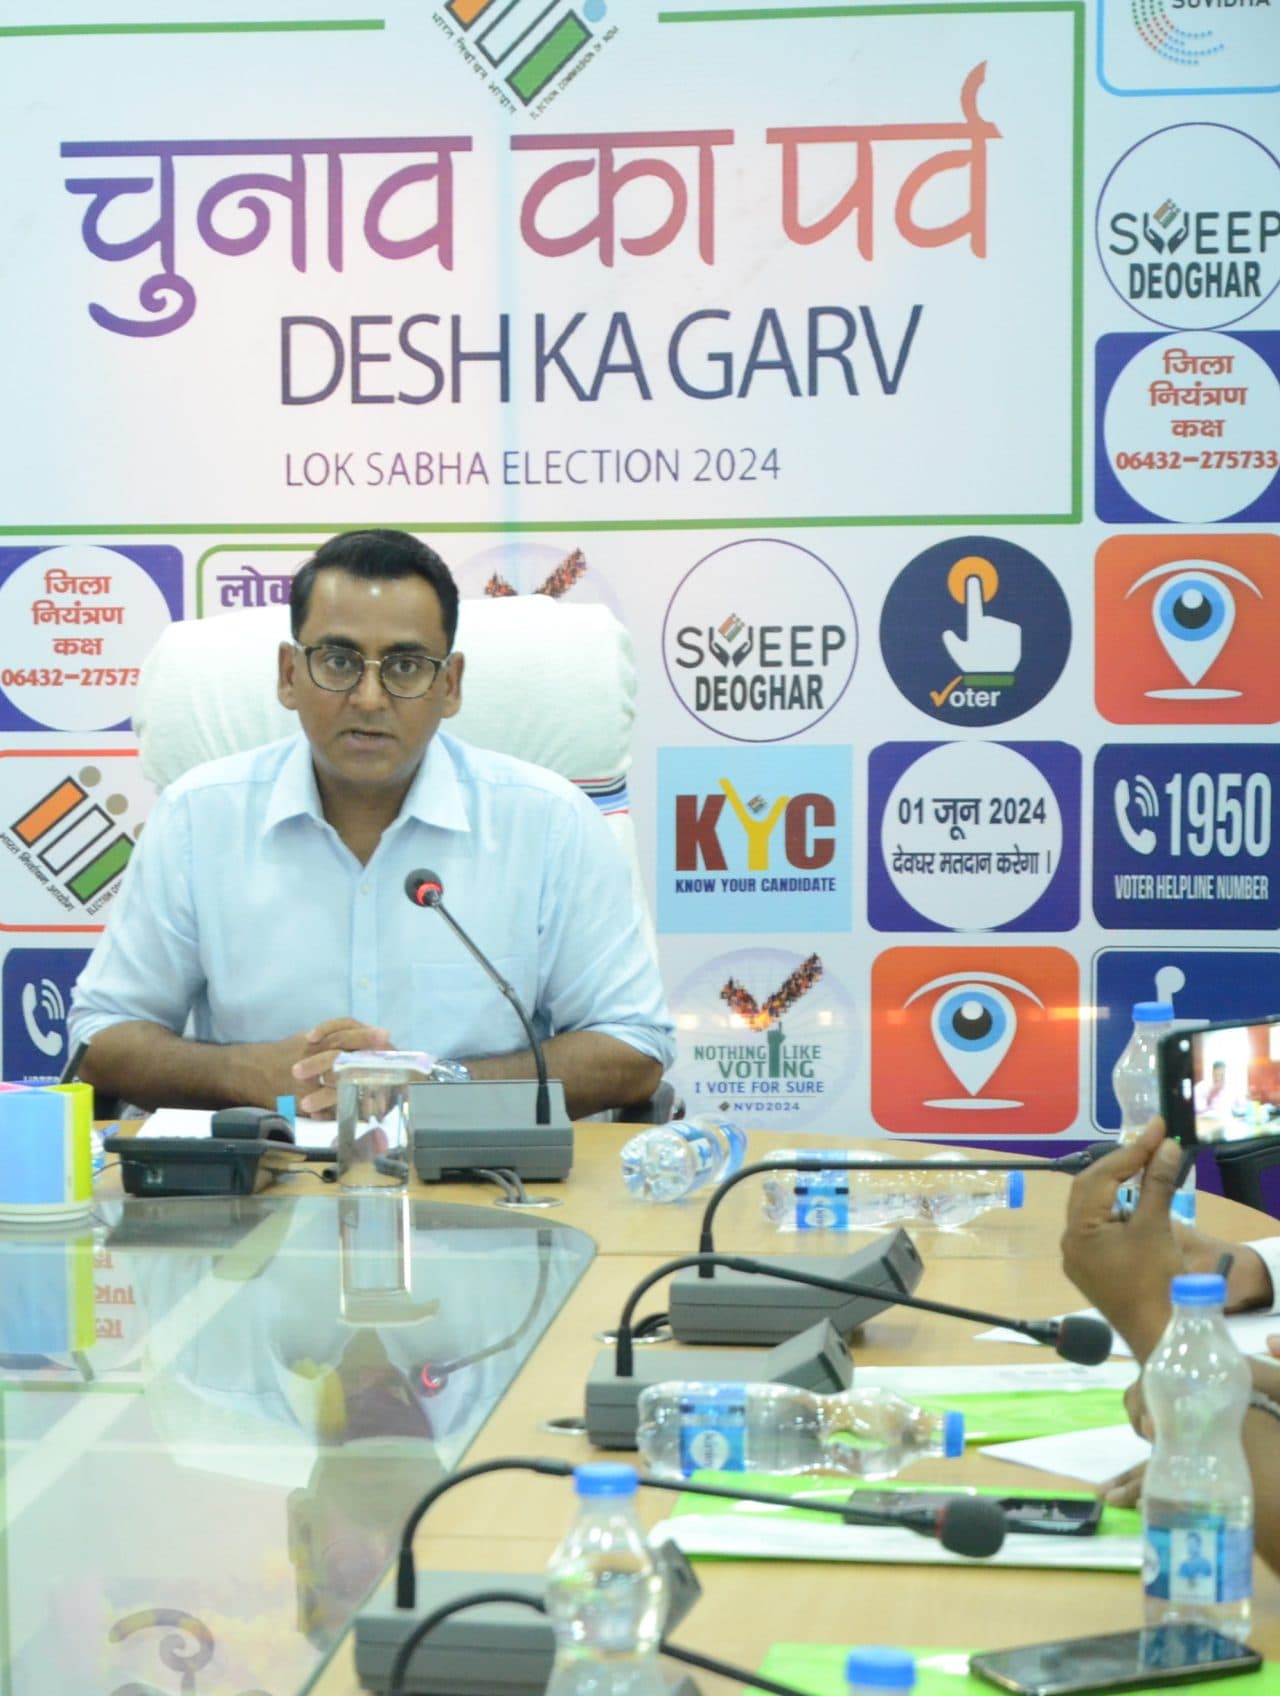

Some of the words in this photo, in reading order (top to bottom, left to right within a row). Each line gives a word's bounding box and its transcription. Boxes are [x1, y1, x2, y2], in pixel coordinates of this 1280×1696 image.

[60, 138, 473, 338] चुनाव
[510, 129, 735, 268] का
[766, 60, 1003, 262] पर्व
[1129, 261, 1261, 299] DEOGHAR
[281, 313, 510, 405] DESH
[535, 312, 653, 402] KA
[668, 304, 924, 400] GARV
[1162, 348, 1235, 375] जिला
[1148, 380, 1248, 406] नियंत्रण
[1171, 420, 1225, 438] कक्ष
[286, 452, 355, 486] LOK
[367, 452, 489, 486] SABHA
[503, 449, 679, 485] ELECTION
[694, 448, 781, 481] 2024
[44, 568, 112, 595] जिला
[31, 599, 125, 625] नियंत्रण
[52, 638, 104, 656] कक्ष
[1, 668, 140, 688] 06432-27573
[696, 674, 824, 711] DEOGHAR
[675, 779, 835, 871] KYC
[899, 798, 923, 824] 01
[932, 798, 982, 840] जून
[989, 797, 1046, 824] 2024
[1165, 773, 1271, 857] 1950
[892, 844, 936, 874] देवघर
[939, 852, 992, 874] मतदान
[996, 844, 1040, 874] करेगा
[676, 879, 715, 893] KNOW
[721, 878, 756, 892] YOUR
[761, 877, 836, 892] CANDIDATE
[1114, 875, 1154, 899] VOTER
[1156, 875, 1214, 899] HELPLINE
[1217, 875, 1268, 900] NUMBER
[695, 1046, 767, 1061] NOTHING
[782, 1045, 821, 1061] LIKE
[695, 1080, 702, 1094] I
[707, 1082, 745, 1093] VOTE
[752, 1081, 779, 1093] FOR
[786, 1081, 824, 1093] SURE
[734, 1102, 800, 1111] NVD2024
